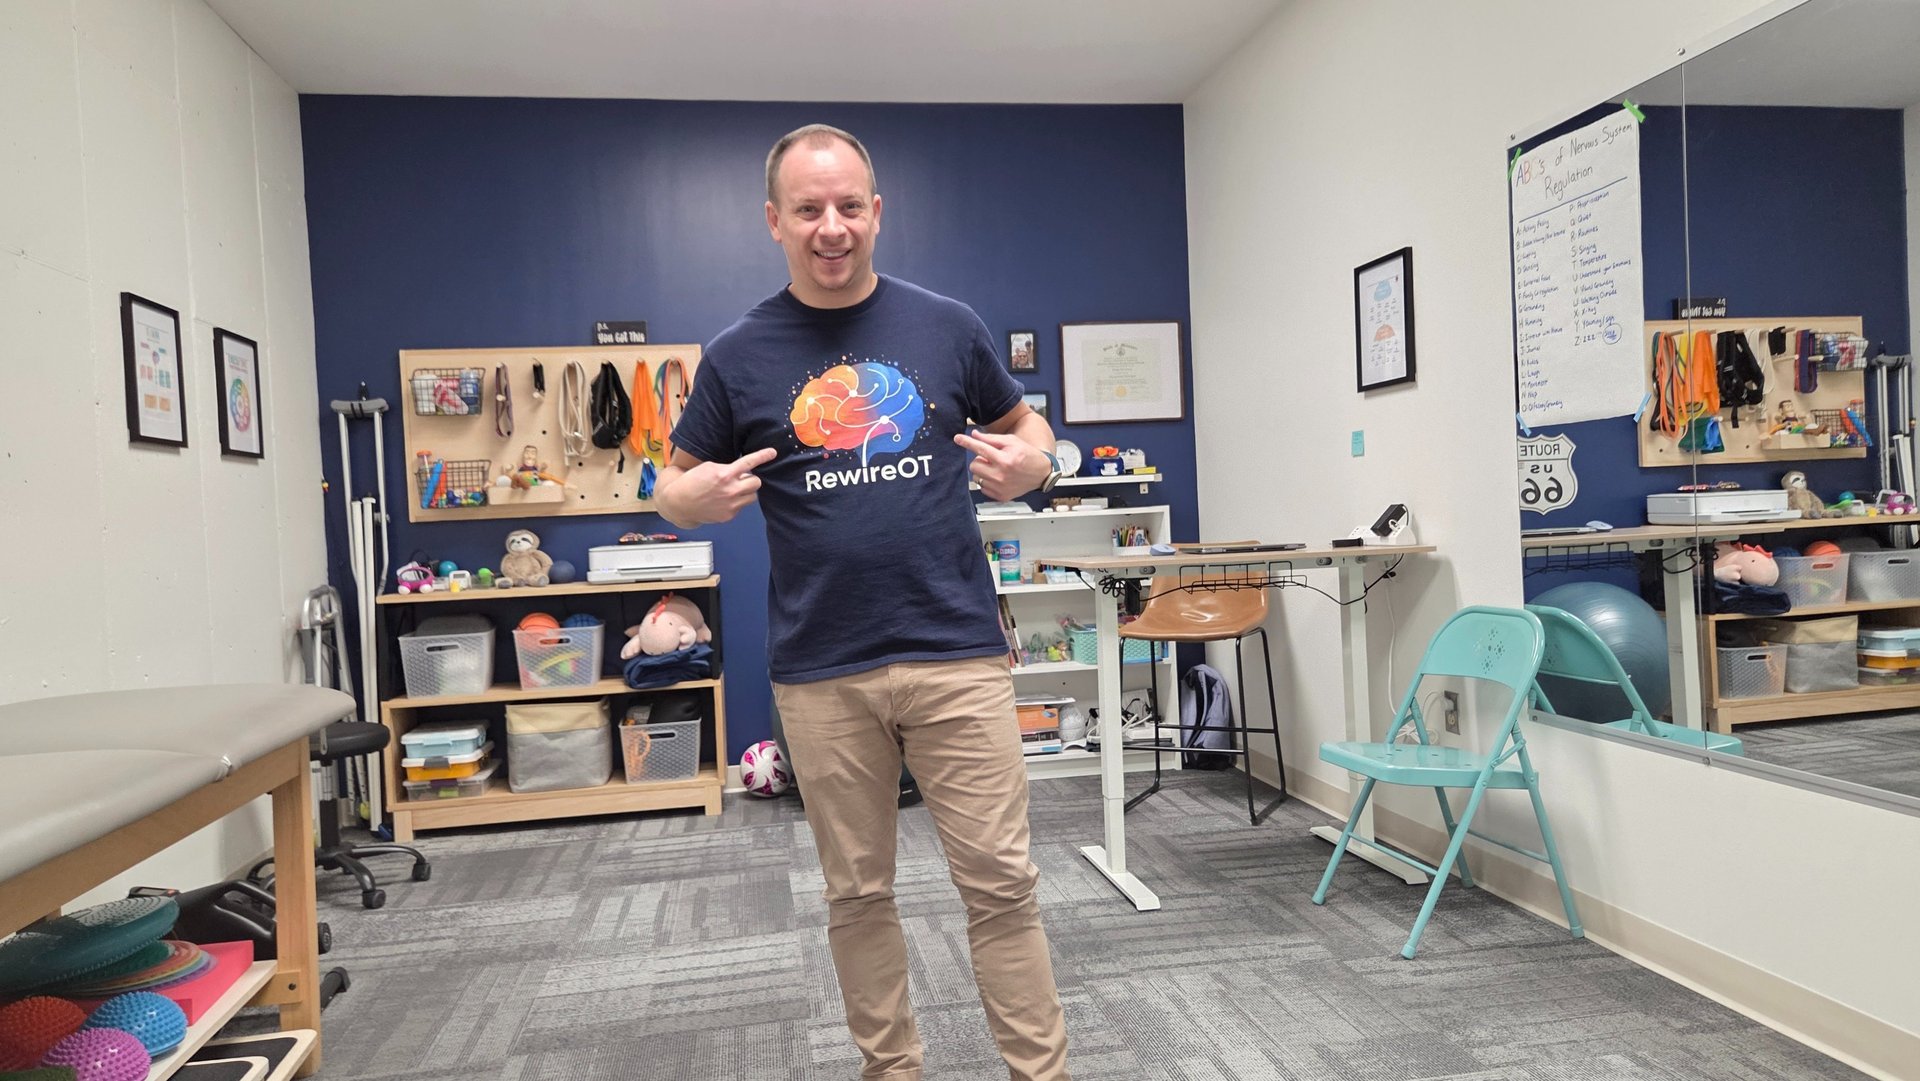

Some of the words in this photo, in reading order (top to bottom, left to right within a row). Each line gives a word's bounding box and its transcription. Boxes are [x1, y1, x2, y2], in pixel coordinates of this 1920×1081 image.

[1516, 158, 1546, 188] ABC's
[1555, 146, 1564, 167] of
[1570, 137, 1599, 158] Nervous
[1601, 123, 1632, 145] System
[1544, 166, 1594, 201] Regulation
[1579, 243, 1597, 255] Singing
[597, 332, 614, 344] You
[614, 331, 628, 343] Got
[805, 455, 933, 492] RewireOT
